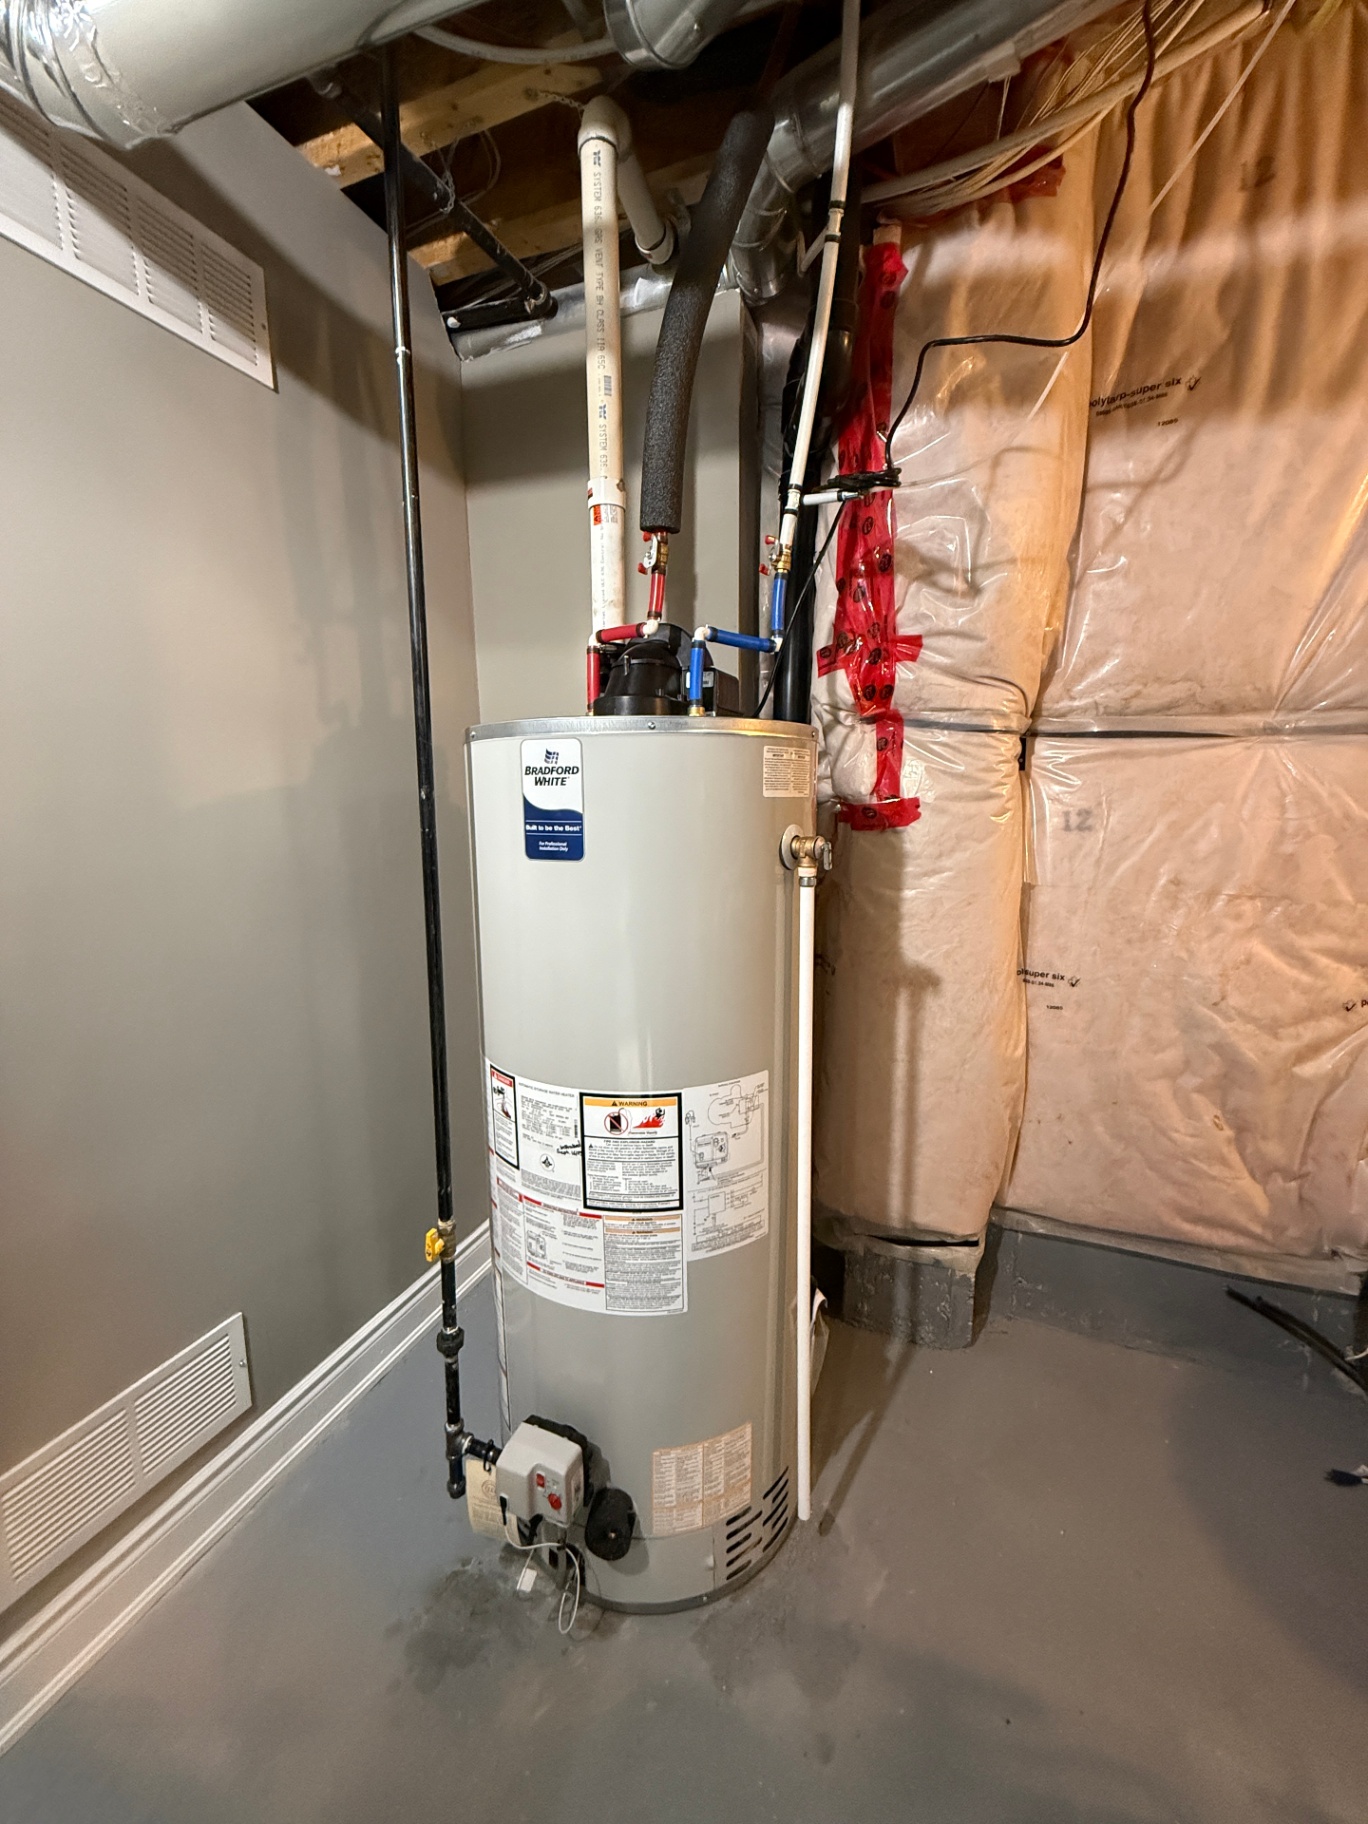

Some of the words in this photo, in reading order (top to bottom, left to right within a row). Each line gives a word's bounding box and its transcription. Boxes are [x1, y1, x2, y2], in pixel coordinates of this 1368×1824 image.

[593, 172, 602, 202] SYSTEM
[594, 248, 604, 267] VENT
[595, 272, 604, 291] TYPE
[596, 309, 605, 333] CLASS
[1164, 377, 1182, 388] six
[598, 423, 608, 451] SYSTEM
[524, 766, 580, 776] BRADFORD
[534, 776, 567, 786] WHITE
[1062, 808, 1093, 832] 12
[1051, 973, 1065, 981] six
